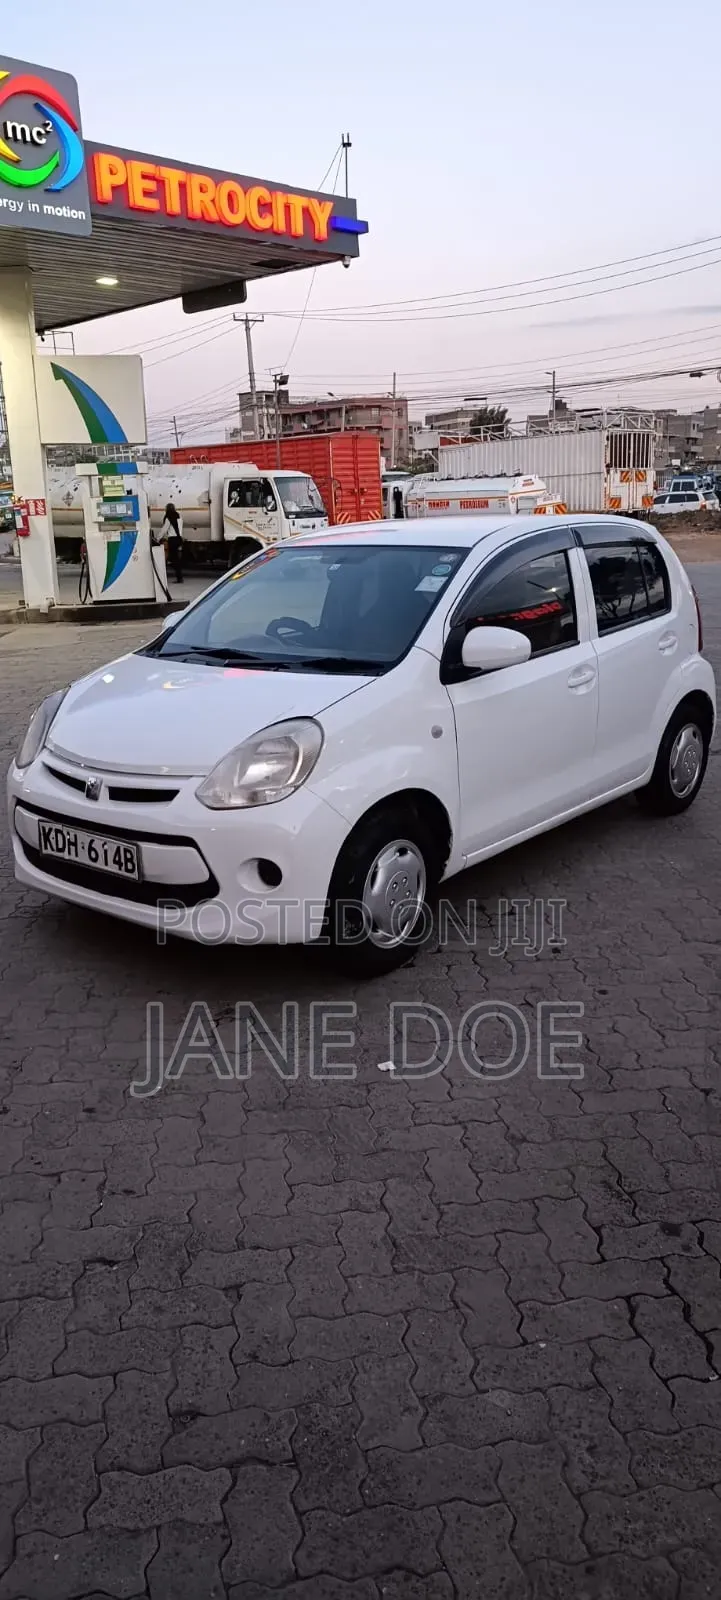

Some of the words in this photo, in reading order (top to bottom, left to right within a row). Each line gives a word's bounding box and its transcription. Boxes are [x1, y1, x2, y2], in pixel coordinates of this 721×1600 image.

[28, 200, 40, 213] in
[43, 204, 86, 220] motion
[93, 151, 335, 242] PETROCITY
[460, 500, 489, 510] PETROLEUM
[42, 825, 78, 857] KDH
[88, 839, 136, 873] 614B
